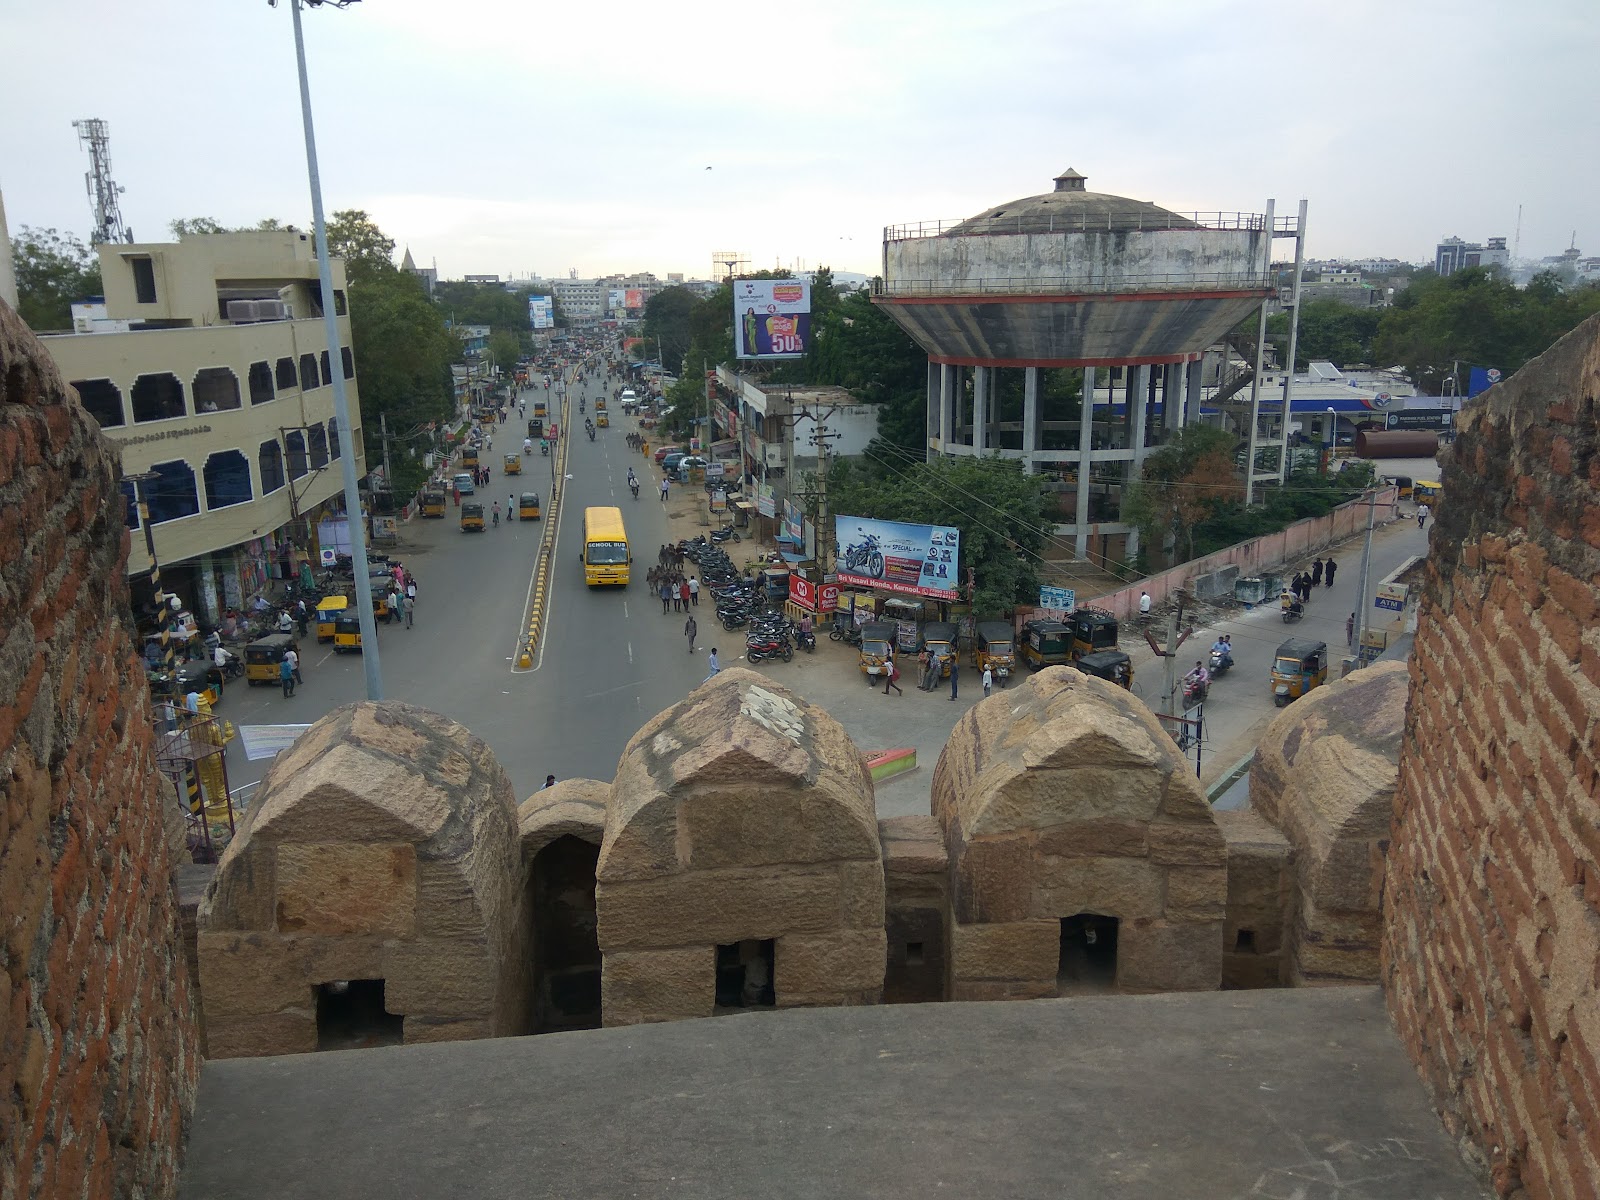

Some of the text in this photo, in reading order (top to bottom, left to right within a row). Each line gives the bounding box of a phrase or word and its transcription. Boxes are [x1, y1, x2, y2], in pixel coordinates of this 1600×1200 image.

[838, 574, 848, 583] Sri
[848, 576, 869, 586] Vasavi
[869, 579, 892, 590] Honda,
[893, 583, 920, 594] Kurnool.
[825, 589, 837, 597] M
[1380, 599, 1397, 607] ATM
